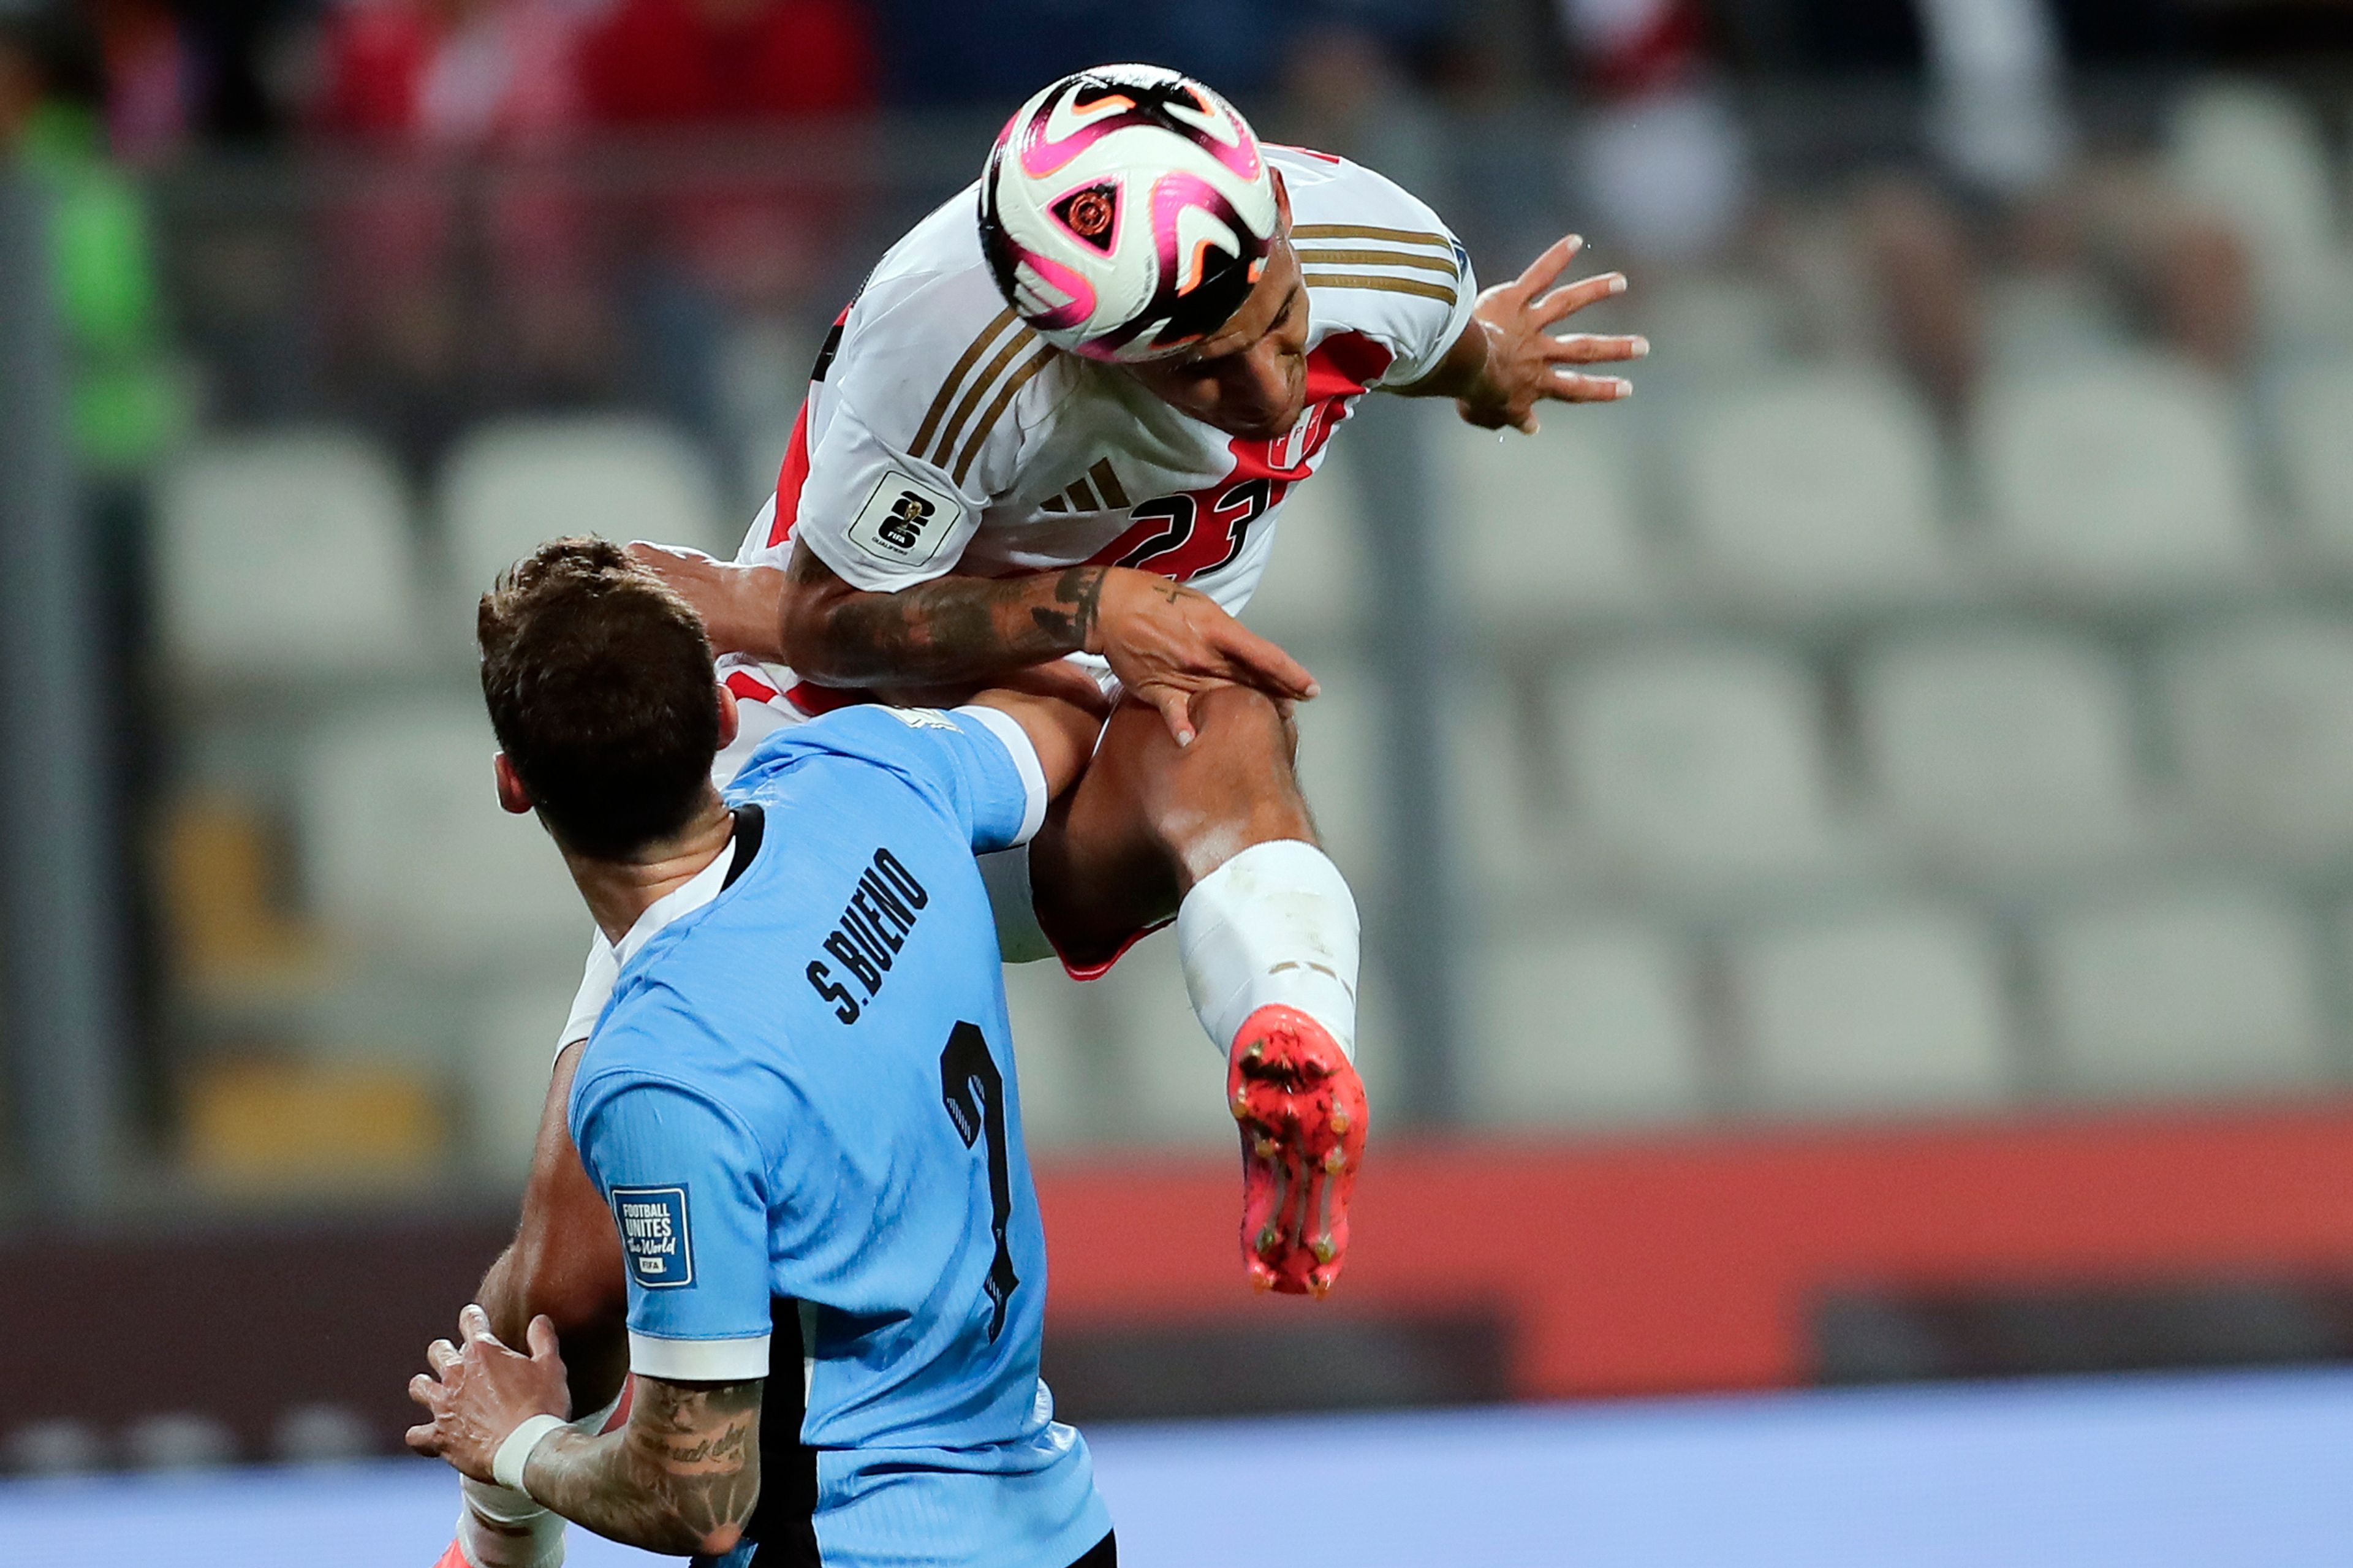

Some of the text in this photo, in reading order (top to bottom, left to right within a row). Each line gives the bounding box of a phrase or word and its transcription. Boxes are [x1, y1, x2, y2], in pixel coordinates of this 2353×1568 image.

[887, 531, 905, 543] FIFA
[1112, 478, 1271, 581] 23
[806, 847, 928, 1025] S.BUENO
[623, 1203, 670, 1217] FOOTBALL
[625, 1218, 672, 1237] UNITES
[641, 1237, 676, 1255] World
